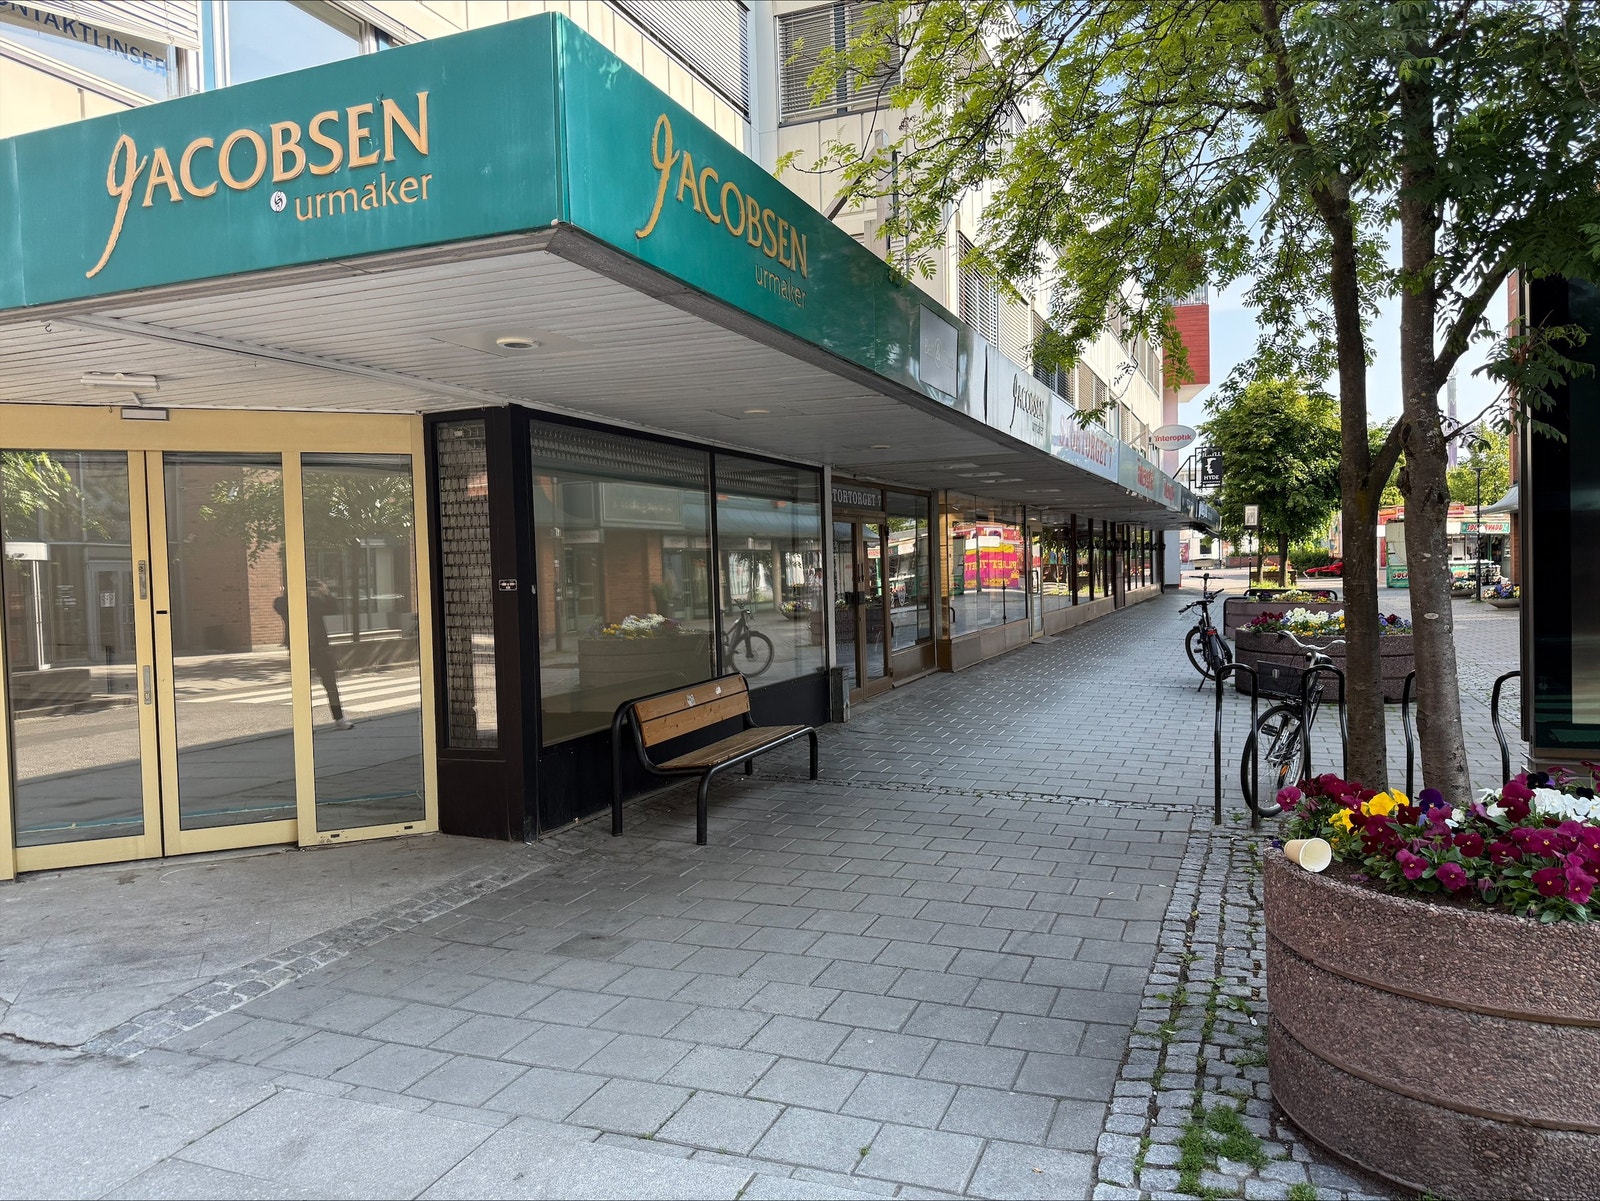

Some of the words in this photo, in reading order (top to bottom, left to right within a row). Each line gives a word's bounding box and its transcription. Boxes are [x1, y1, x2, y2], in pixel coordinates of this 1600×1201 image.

[85, 91, 429, 279] JACOBSEN
[295, 172, 433, 222] urmaker
[635, 113, 808, 279] JACOBSEN
[755, 264, 808, 309] urmaker
[832, 488, 876, 507] TORTORGET
